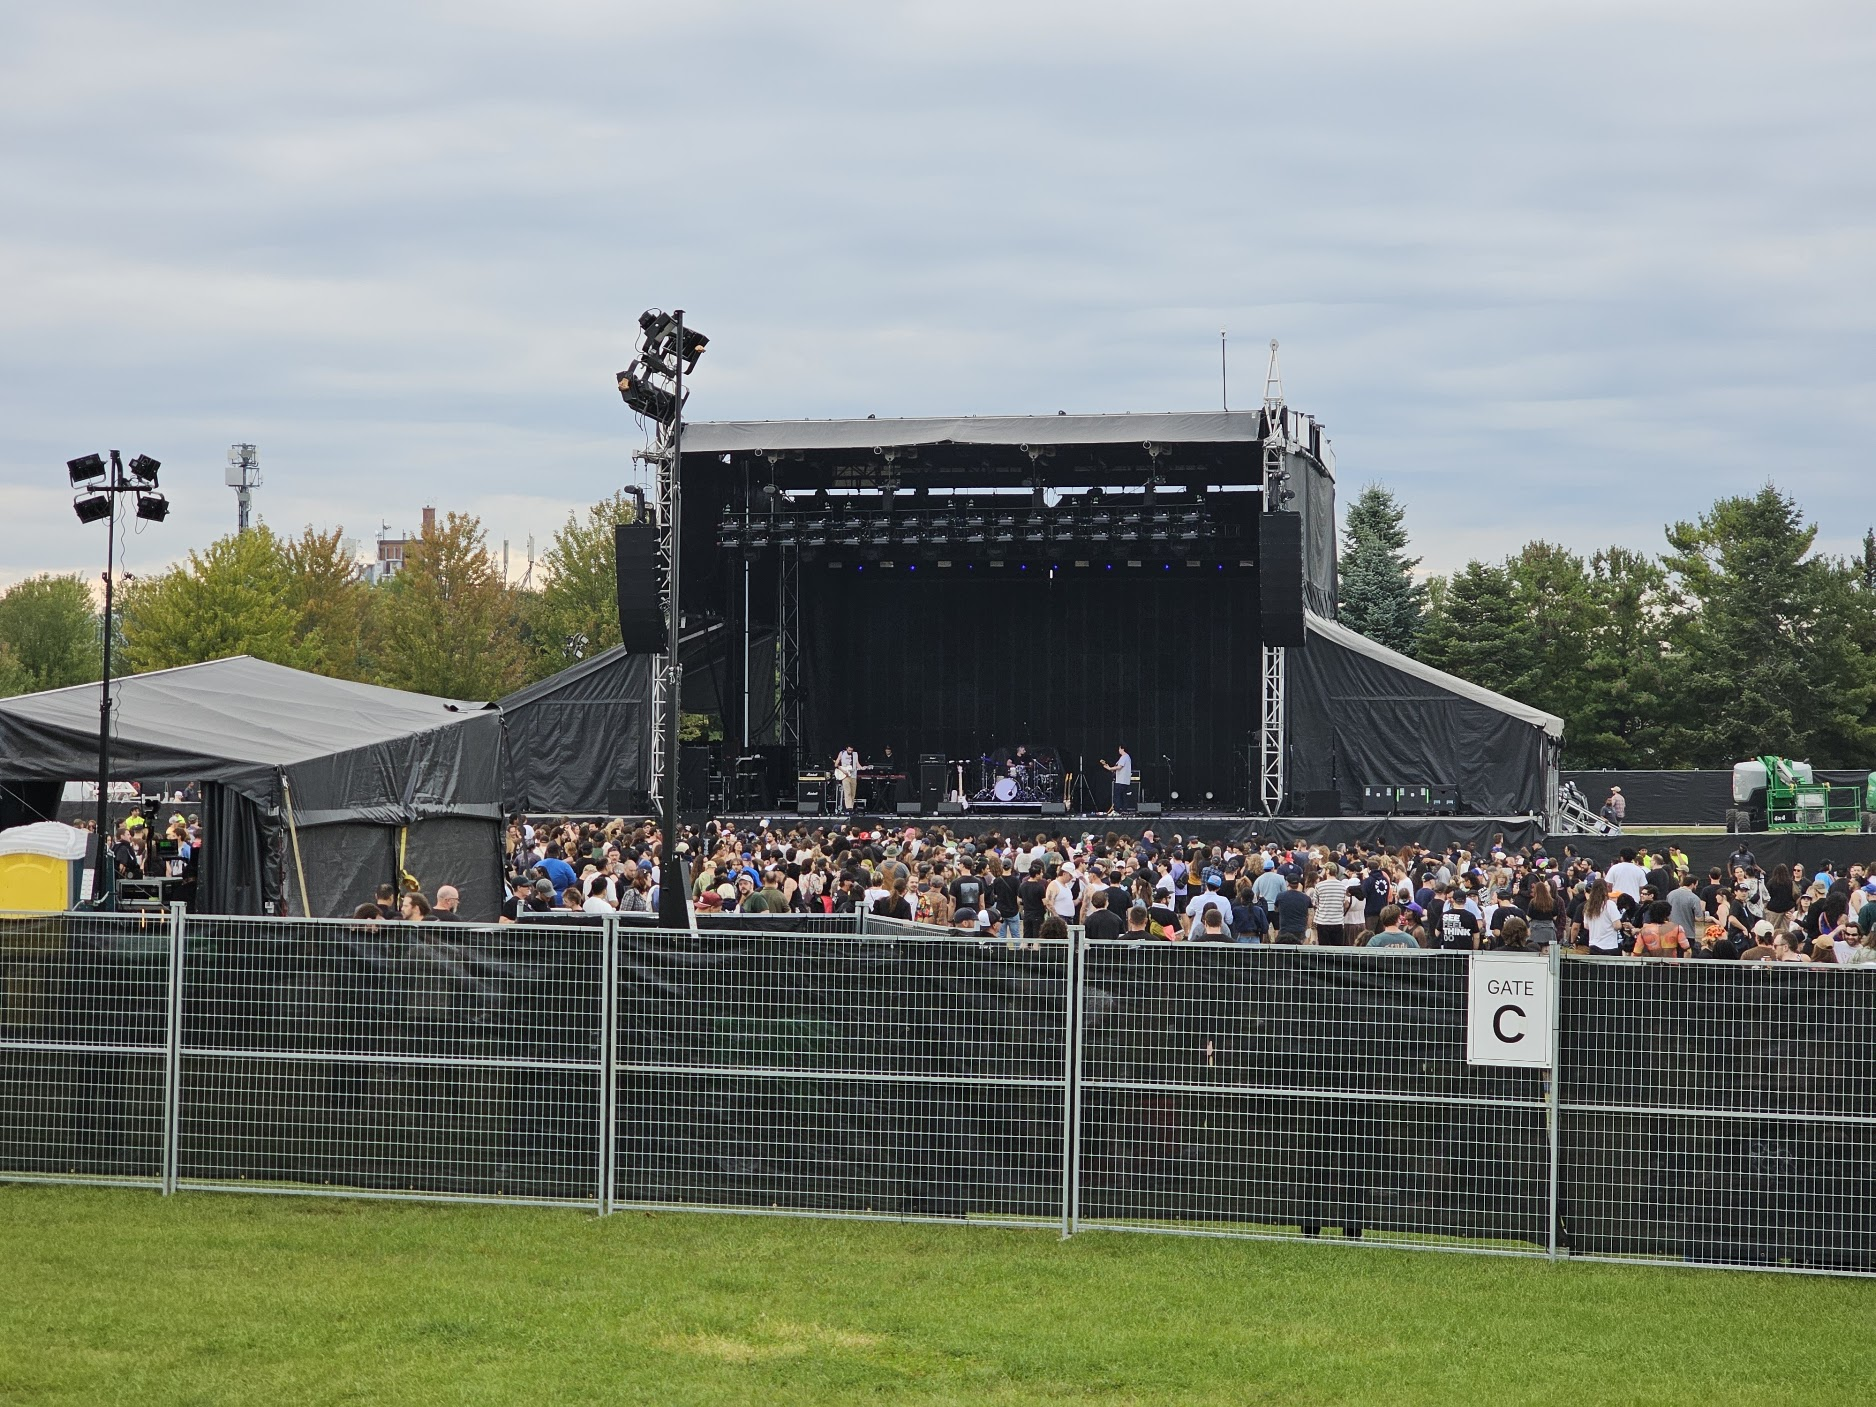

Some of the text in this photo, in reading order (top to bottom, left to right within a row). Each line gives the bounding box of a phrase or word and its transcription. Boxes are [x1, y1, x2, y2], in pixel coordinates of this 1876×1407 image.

[1443, 920, 1464, 928] FEEL
[1443, 927, 1471, 936] THINK
[1487, 979, 1534, 996] GATE
[1493, 1004, 1527, 1043] C
